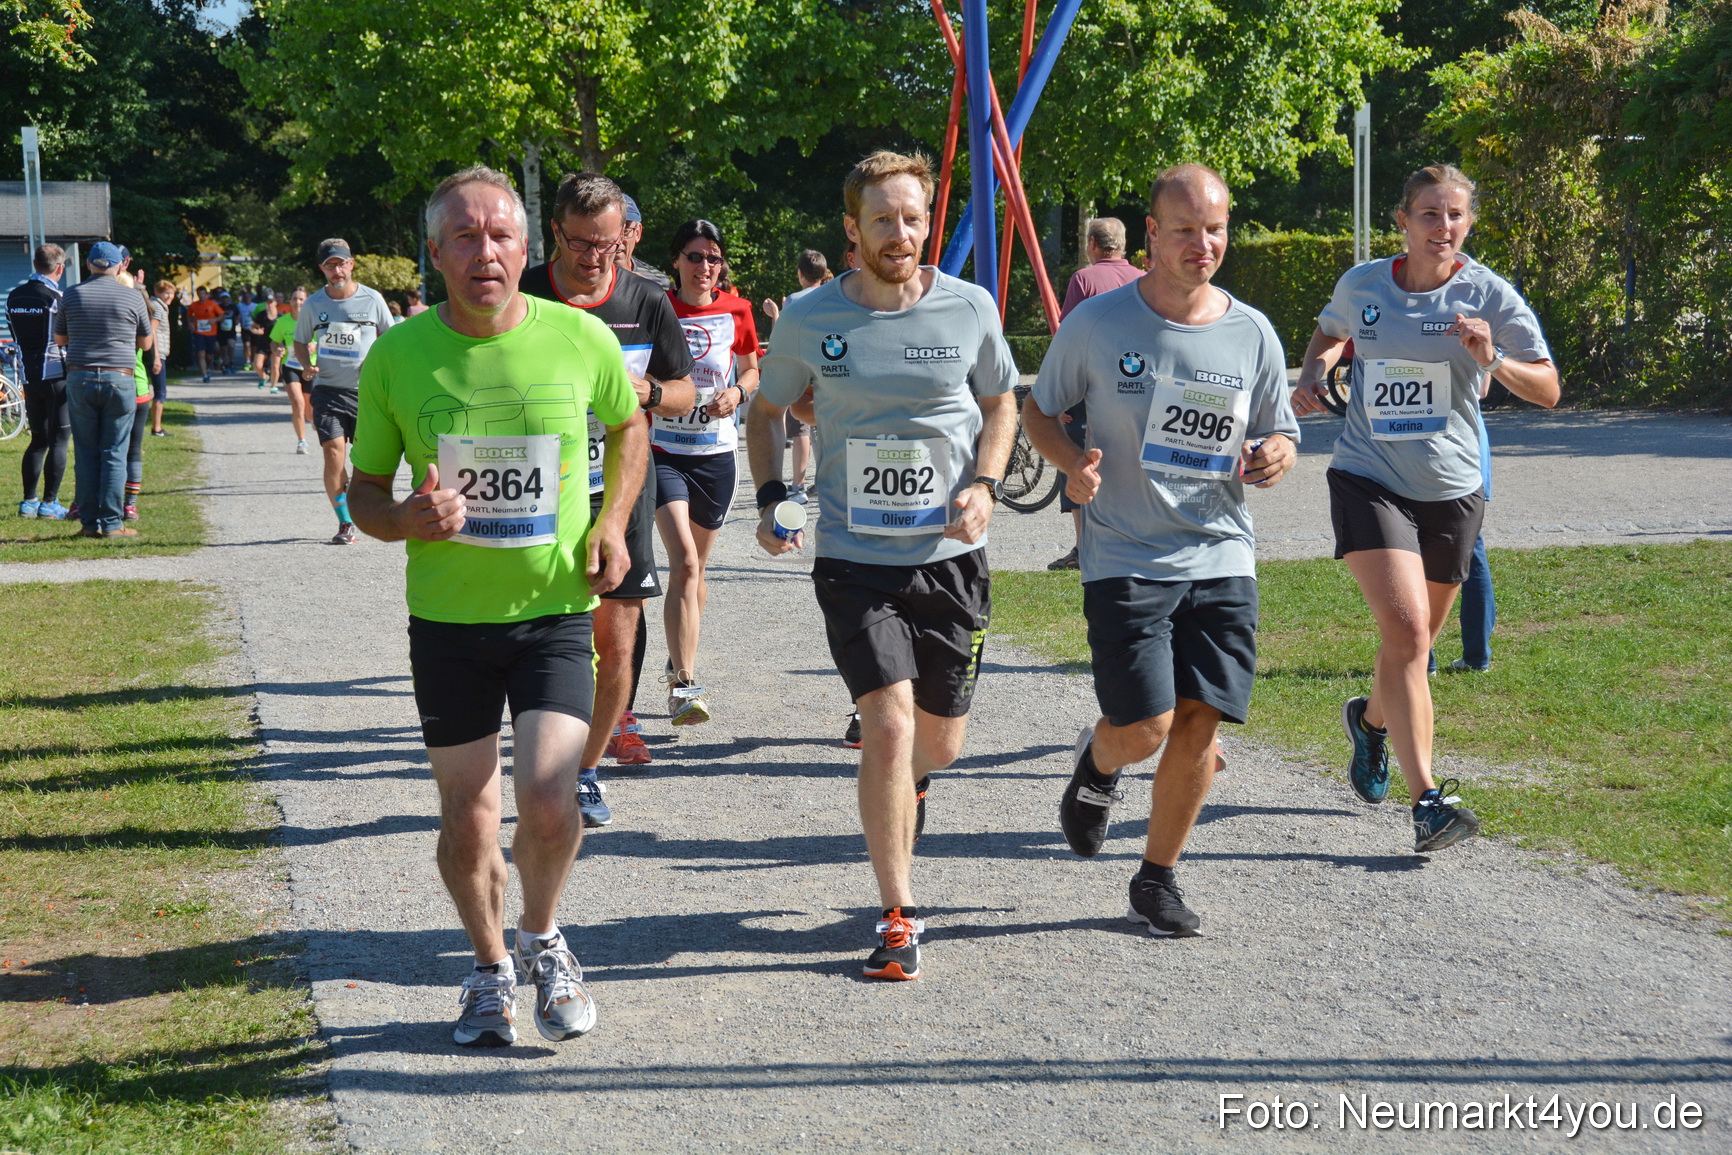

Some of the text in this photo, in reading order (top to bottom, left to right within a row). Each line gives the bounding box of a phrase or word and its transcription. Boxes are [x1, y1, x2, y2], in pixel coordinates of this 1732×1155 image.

[325, 333, 355, 345] 2159
[1359, 329, 1377, 337] PARTL
[905, 346, 960, 359] BOCK
[821, 364, 850, 373] PARTL
[1385, 367, 1425, 375] BOCK
[1117, 381, 1146, 389] PARTL
[1195, 370, 1244, 389] BOCK
[1183, 389, 1227, 407] BOCK
[1374, 381, 1433, 407] 2021
[1161, 405, 1234, 442] 2996
[1389, 420, 1423, 432] Karina
[675, 434, 697, 444] Doris
[1165, 436, 1215, 451] PARTL Neumarkt
[474, 447, 528, 458] BOCK
[877, 449, 921, 459] BOCK
[1170, 451, 1209, 469] Robert
[457, 467, 543, 500] 2364
[863, 466, 934, 496] 2062
[1161, 480, 1218, 491] Neumarkter
[882, 513, 917, 525] Oliver
[468, 520, 534, 536] Wolfgang
